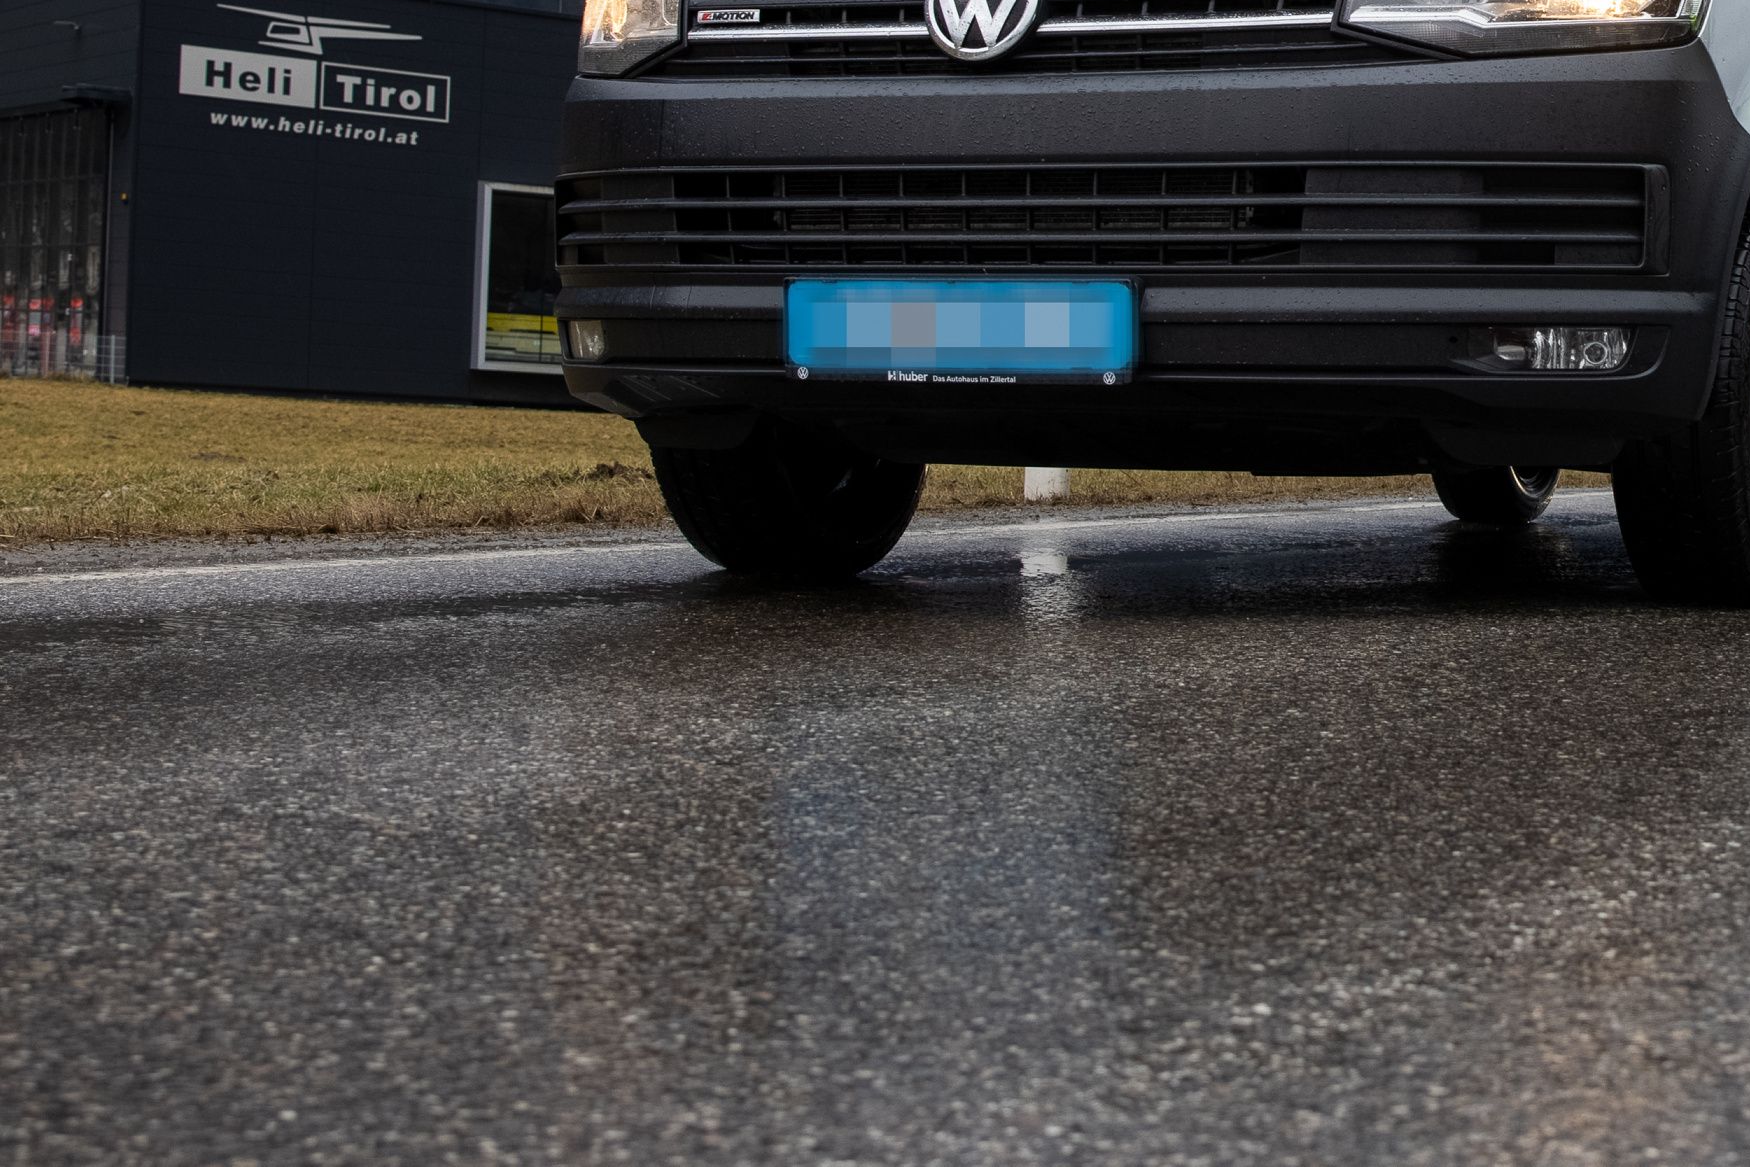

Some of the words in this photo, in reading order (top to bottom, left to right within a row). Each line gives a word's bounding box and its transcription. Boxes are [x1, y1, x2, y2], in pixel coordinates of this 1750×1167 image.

[204, 59, 292, 96] Heli
[336, 74, 436, 113] Tirol
[210, 111, 419, 146] www.heli-tirol.at
[899, 370, 928, 382] huber
[946, 375, 979, 383] Autohaus
[979, 375, 989, 383] im
[990, 375, 1016, 383] Zillertal
